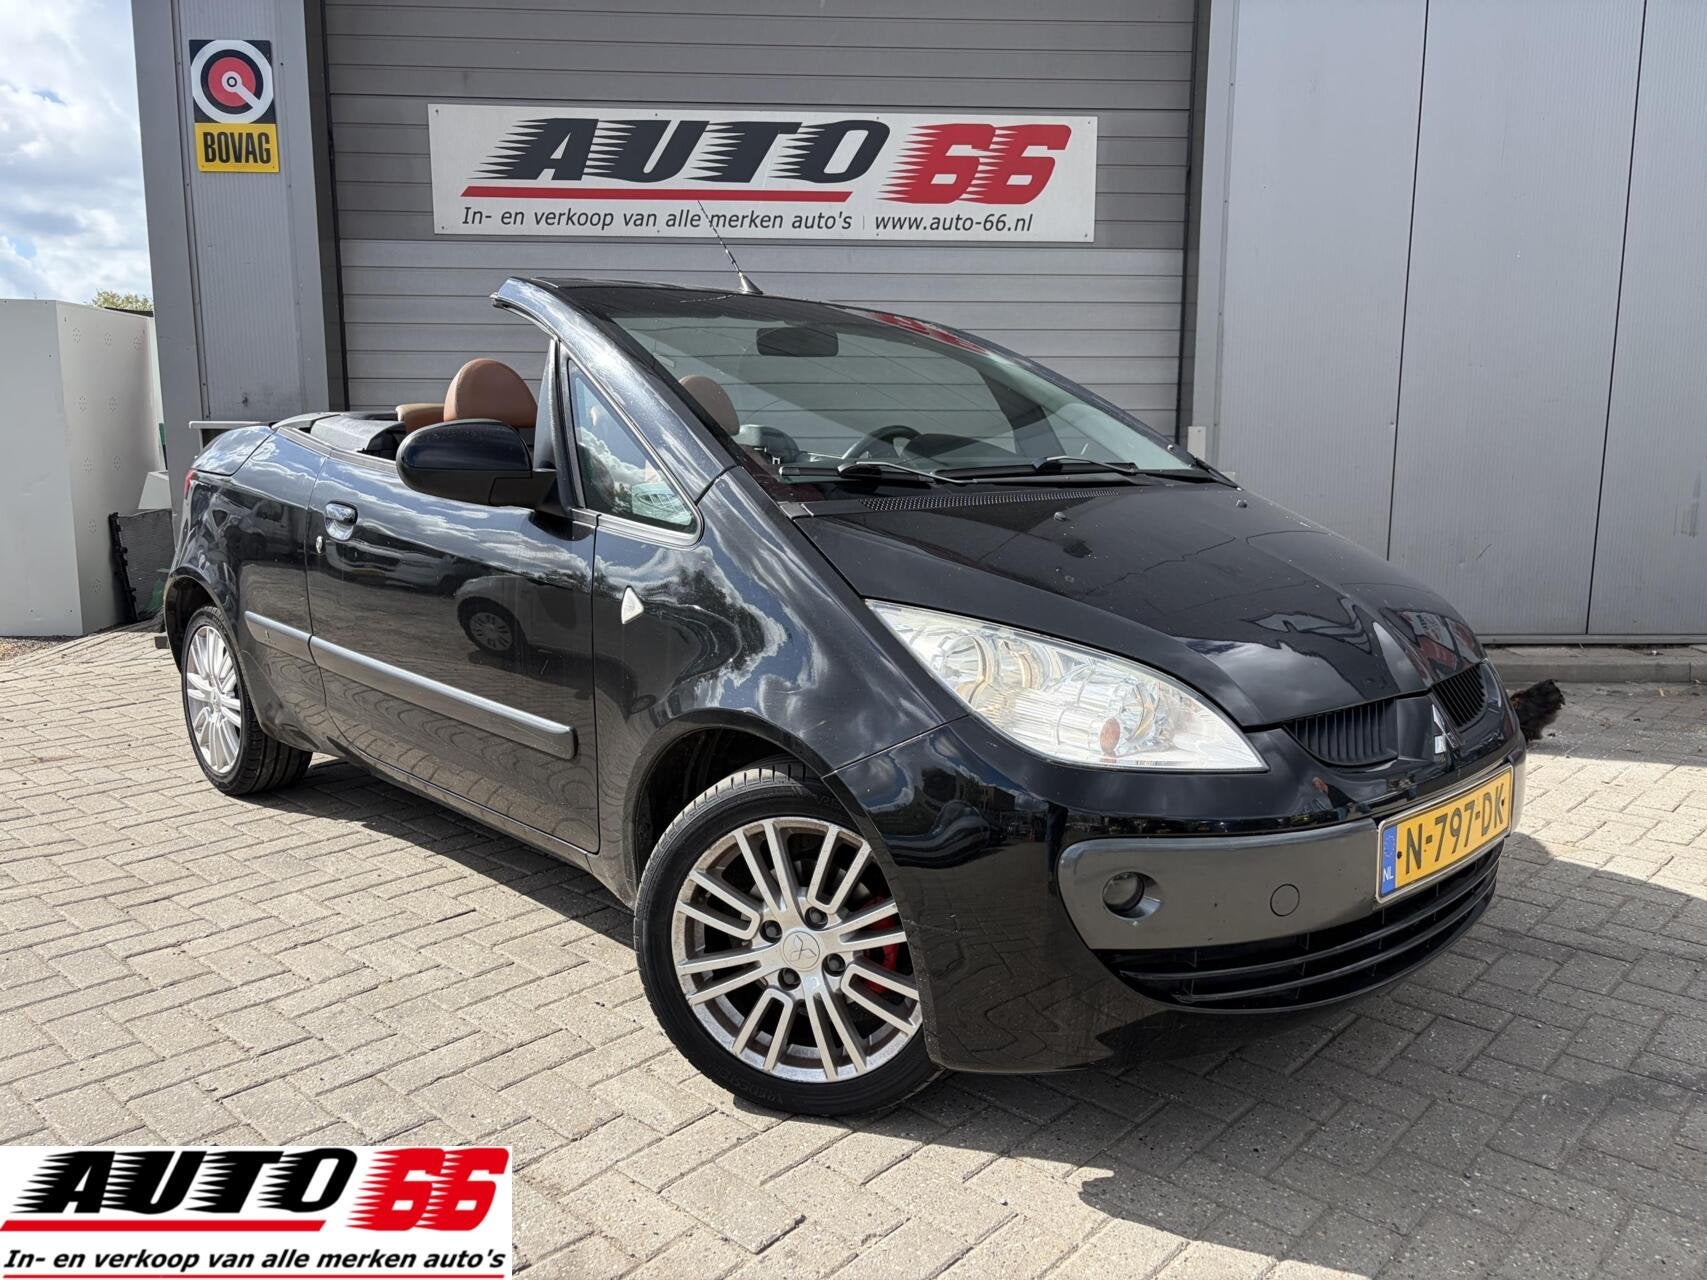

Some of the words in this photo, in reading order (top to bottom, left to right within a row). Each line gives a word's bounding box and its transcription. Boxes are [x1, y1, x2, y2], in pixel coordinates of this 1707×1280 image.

[203, 131, 272, 164] BOVAG
[466, 117, 891, 183] AUTO
[877, 123, 1072, 204] 66
[462, 207, 492, 225] In-
[501, 209, 525, 225] en
[534, 208, 614, 231] verkoop
[623, 212, 657, 227] van
[665, 209, 701, 228] alle
[709, 210, 783, 229] merken
[791, 211, 852, 230] auto's
[875, 213, 1033, 232] www.auto-66.nl
[1405, 782, 1505, 876] N-797-DK
[1382, 865, 1395, 883] NL
